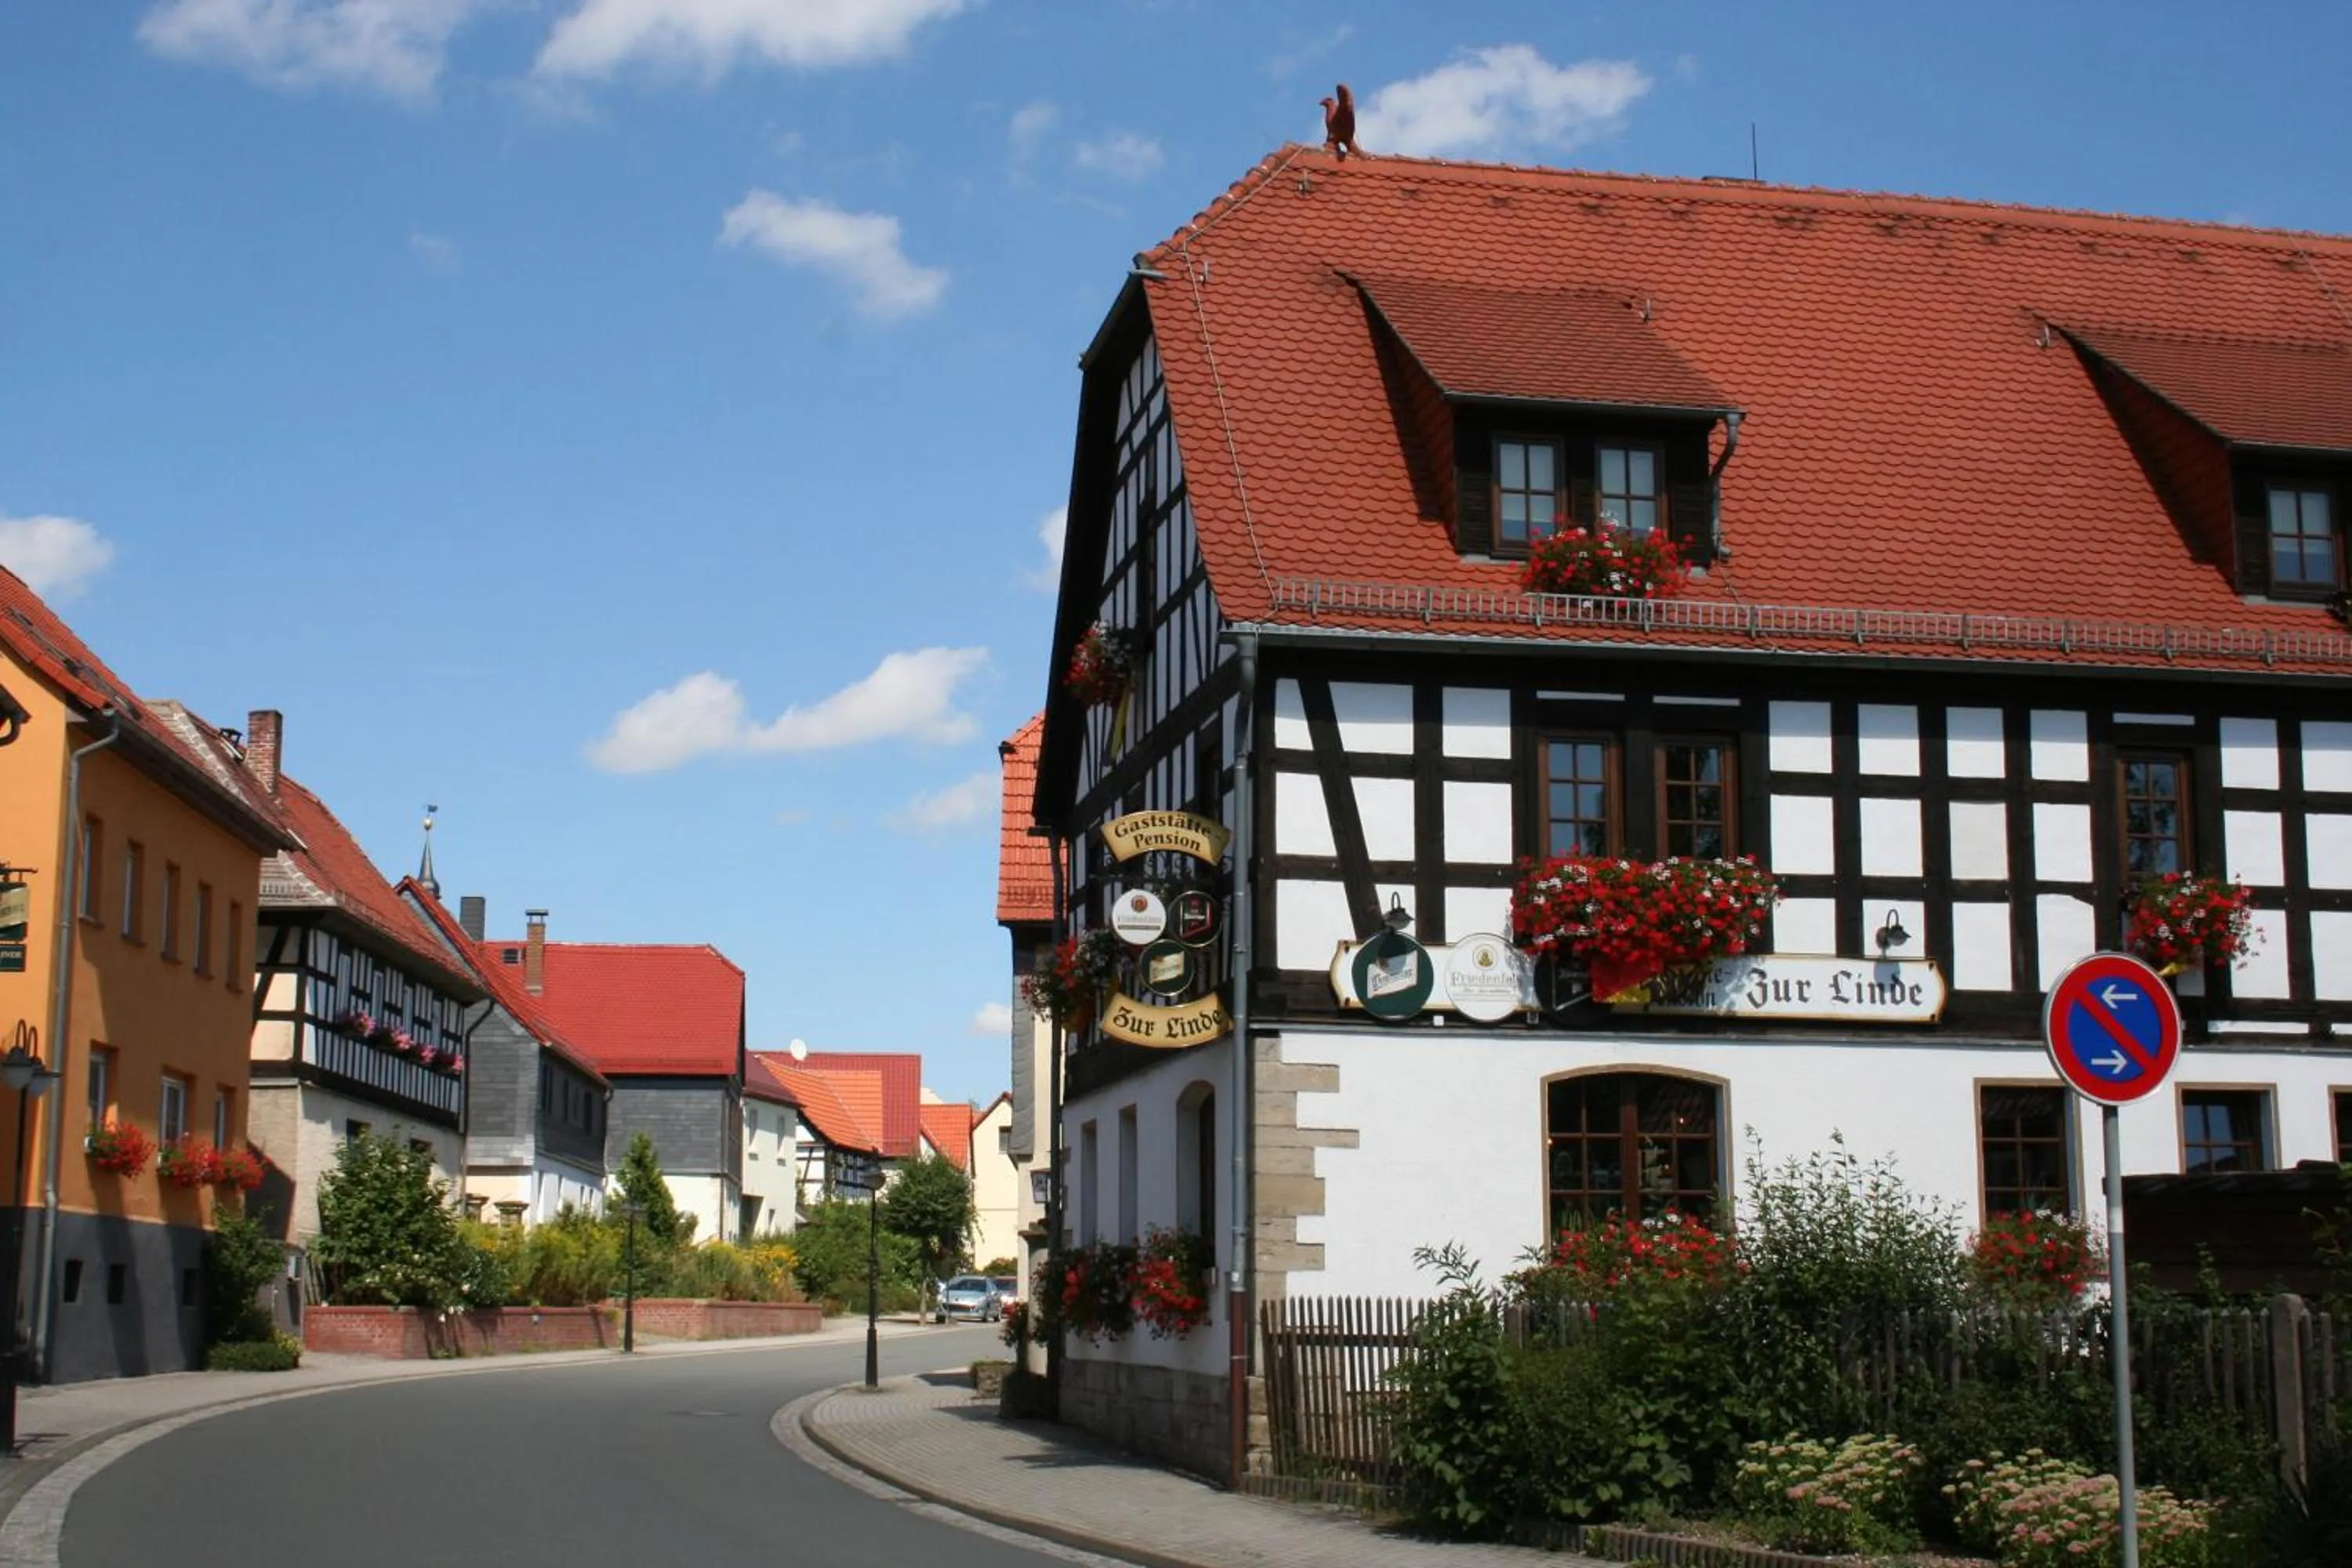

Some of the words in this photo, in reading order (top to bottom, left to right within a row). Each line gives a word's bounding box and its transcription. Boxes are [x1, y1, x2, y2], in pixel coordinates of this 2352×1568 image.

[1134, 831, 1201, 851] Pension
[1747, 967, 1811, 1009] Zur
[1829, 970, 1922, 1006] Linde
[1112, 1006, 1156, 1036] Zur
[1166, 1009, 1221, 1039] Linde
